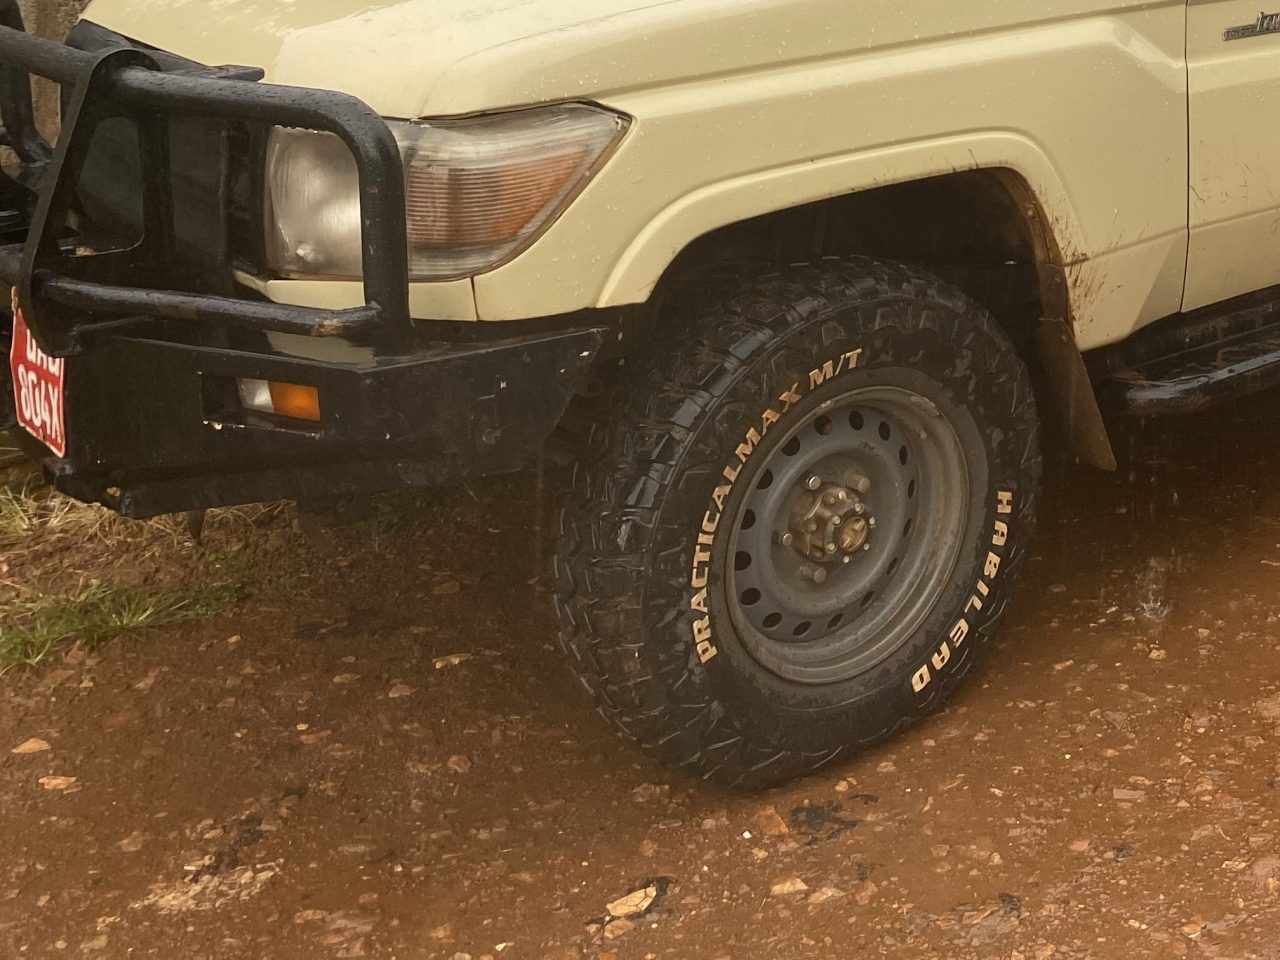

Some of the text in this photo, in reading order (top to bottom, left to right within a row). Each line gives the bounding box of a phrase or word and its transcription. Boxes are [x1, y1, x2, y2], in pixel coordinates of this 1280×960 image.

[1225, 27, 1257, 39] TOYOTA
[808, 347, 863, 390] M/T
[910, 490, 1013, 693] HABILEAD
